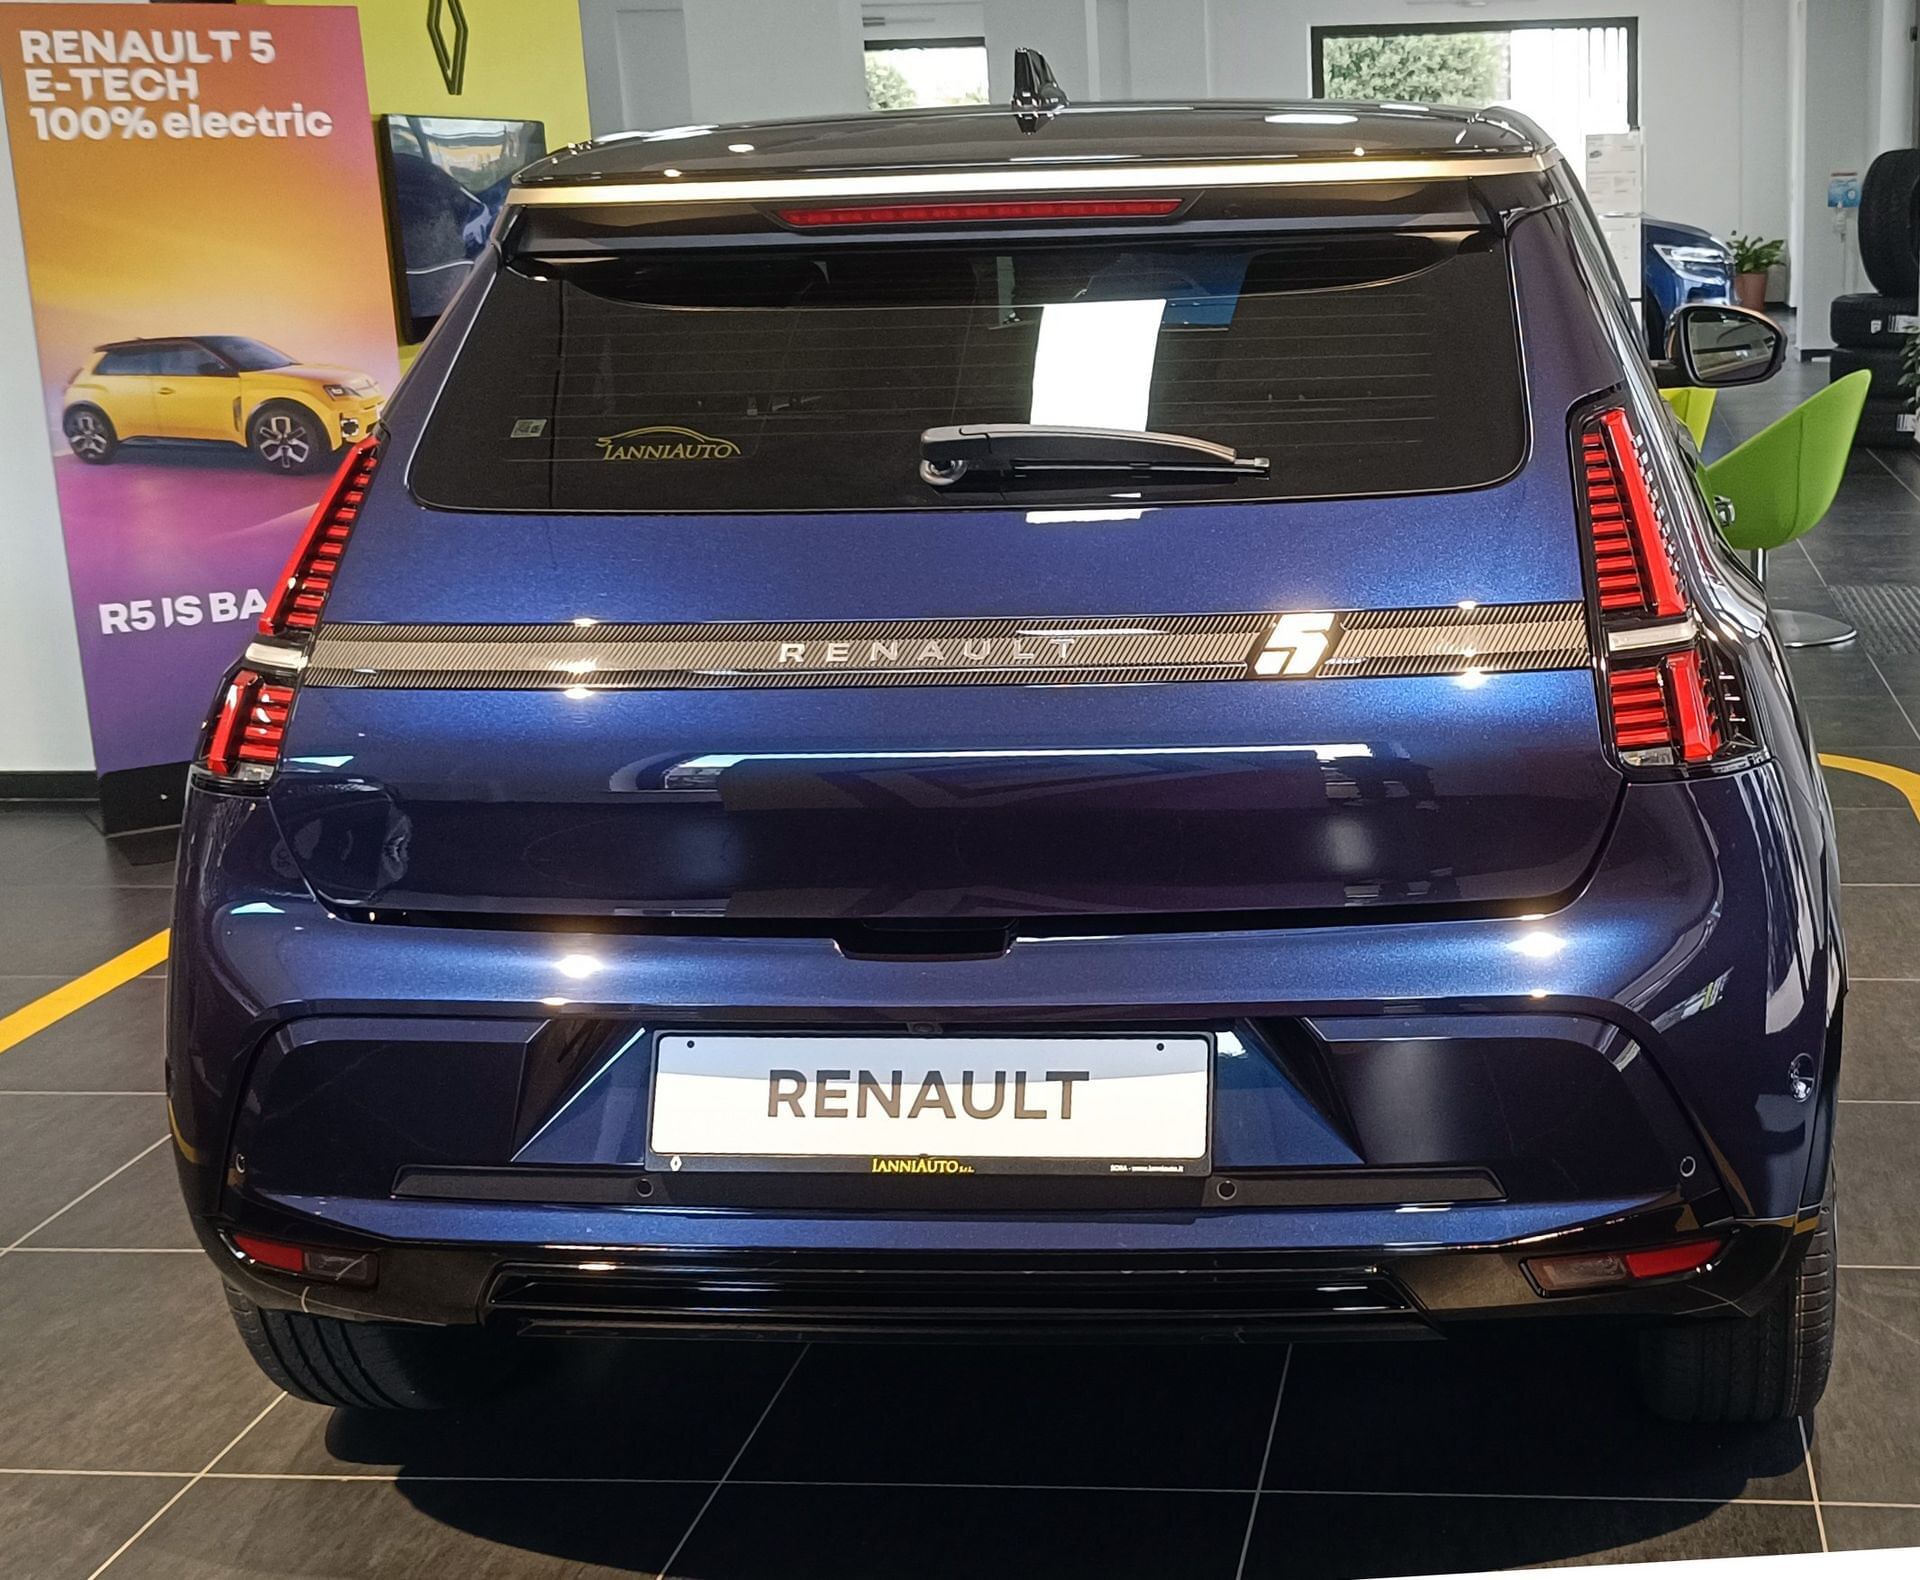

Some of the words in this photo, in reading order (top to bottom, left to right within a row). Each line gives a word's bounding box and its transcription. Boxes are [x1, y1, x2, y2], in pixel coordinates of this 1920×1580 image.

[20, 30, 240, 64] RENAULT
[249, 30, 276, 64] 5
[25, 68, 200, 102] E-TECH
[30, 106, 157, 141] 100%
[162, 102, 333, 139] electric
[99, 600, 156, 635] R5
[161, 595, 203, 628] IS
[779, 638, 1075, 663] RENAULT
[767, 1069, 1090, 1120] RENAULT
[871, 1158, 959, 1173] IANNIAUTO
